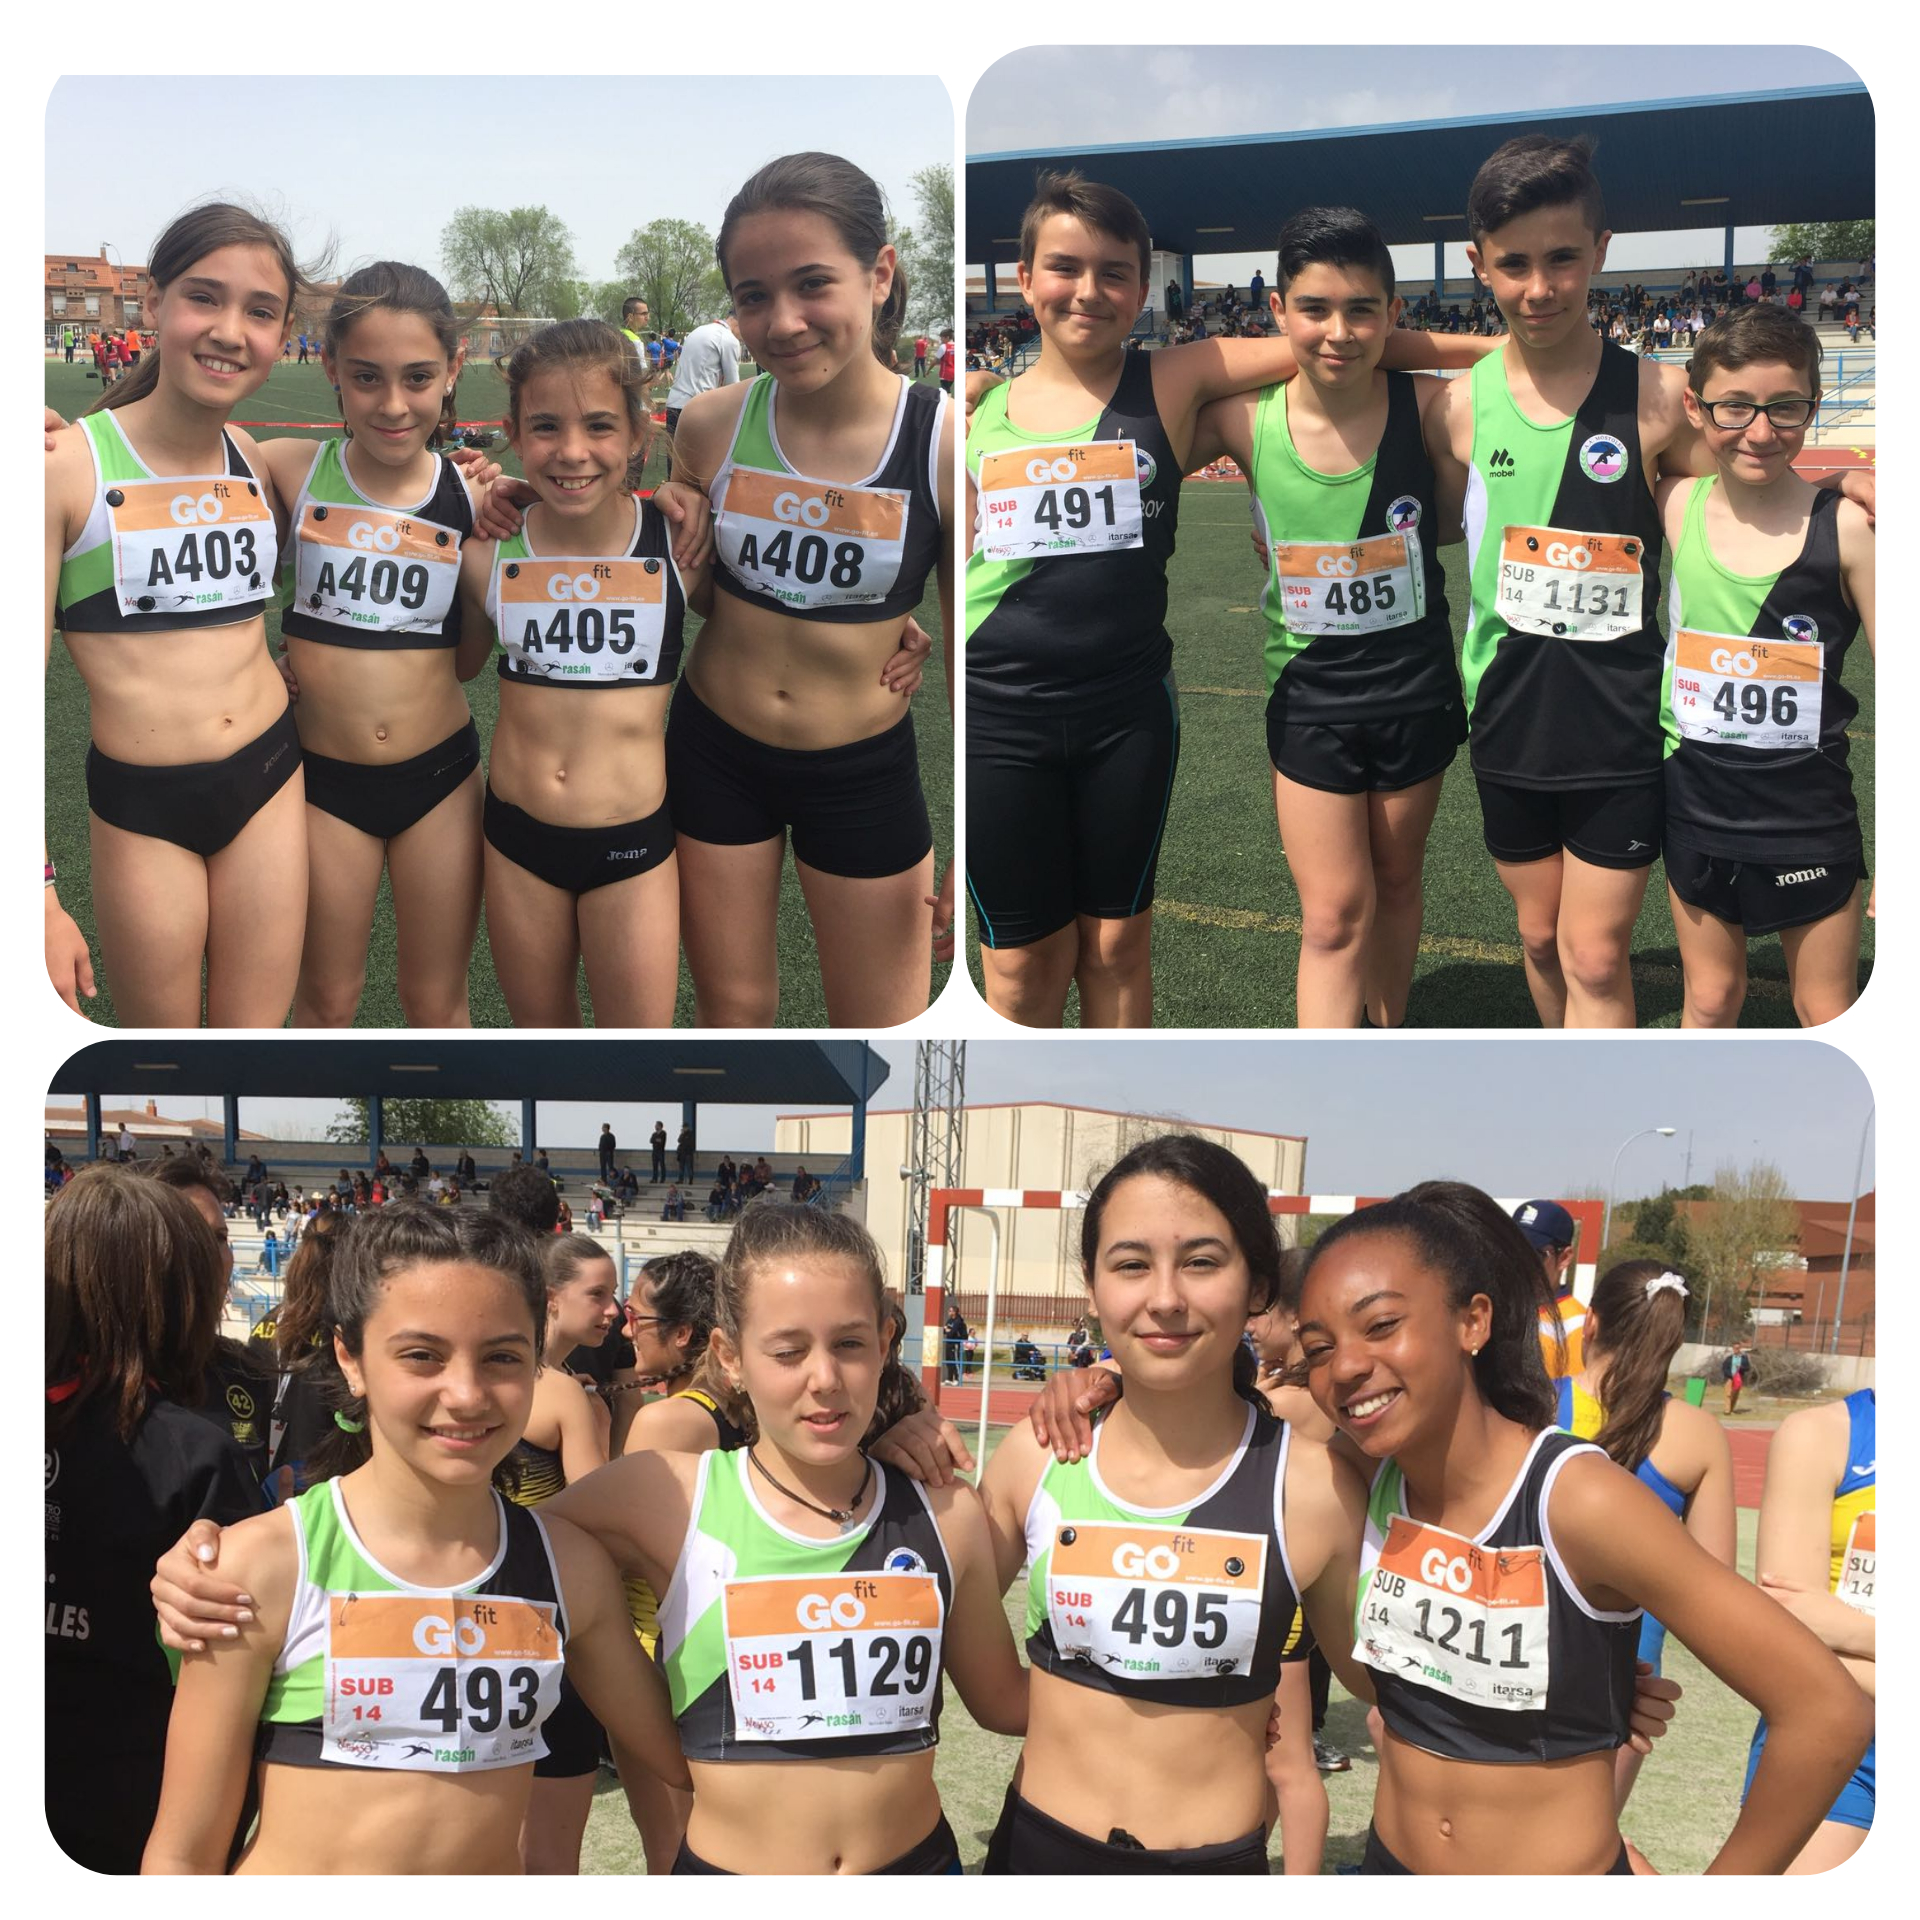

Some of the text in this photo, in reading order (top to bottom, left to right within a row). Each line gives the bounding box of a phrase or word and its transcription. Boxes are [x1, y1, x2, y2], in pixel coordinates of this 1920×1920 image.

[1025, 448, 1087, 484] GO fit
[1489, 469, 1515, 478] mobel
[170, 483, 231, 525] GO fit
[773, 490, 845, 527] GO fit
[989, 500, 1018, 514] SUB
[1034, 485, 1116, 531] 491
[997, 517, 1014, 529] 14
[348, 520, 412, 551] GO fit
[1108, 532, 1135, 541] itarsa
[148, 528, 257, 587] A403
[738, 529, 865, 589] A408
[1316, 546, 1365, 576] GO fit
[1545, 538, 1603, 570] GO fit
[547, 564, 612, 600] GO fit
[1503, 564, 1535, 582] SUB
[316, 556, 429, 610] A409
[1287, 585, 1312, 596] SUB
[196, 590, 223, 604] rasán
[775, 588, 807, 605] rasán
[1325, 574, 1396, 616] 485
[1505, 587, 1524, 604] 14
[1543, 579, 1630, 618] 1131
[1294, 600, 1308, 609] 14
[351, 613, 381, 625] rasán
[1337, 620, 1360, 630] rasán
[1386, 610, 1408, 622] itarsa
[522, 608, 636, 655] A405
[562, 663, 591, 674] rasán
[1710, 645, 1769, 677] GO fit
[1678, 679, 1701, 692] SUB
[1683, 696, 1697, 707] 14
[1713, 681, 1798, 727] 496
[1720, 730, 1748, 740] rasán
[1781, 731, 1809, 741] itarsa
[1112, 1535, 1195, 1580] GO fit
[1420, 1548, 1483, 1594] GO fit
[1374, 1569, 1406, 1599] SUB
[1850, 1580, 1874, 1597] 14
[796, 1580, 878, 1630] GO fit
[1055, 1591, 1092, 1608] SUB
[1065, 1615, 1086, 1628] 14
[1111, 1587, 1228, 1649] 495
[1368, 1602, 1390, 1626] 14
[412, 1604, 498, 1656] GO fit
[1413, 1598, 1530, 1670] 1211
[738, 1653, 783, 1670] SUB
[787, 1635, 932, 1701] 1129
[1123, 1658, 1160, 1673] rasán
[1422, 1662, 1453, 1686] rasán
[340, 1678, 394, 1696] SUB
[752, 1678, 776, 1694] 14
[1493, 1683, 1533, 1697] itarsa
[420, 1666, 540, 1734] 493
[352, 1705, 382, 1721] 14
[826, 1710, 862, 1727] rasán
[899, 1705, 924, 1718] itarsa
[434, 1746, 475, 1763] rasán
